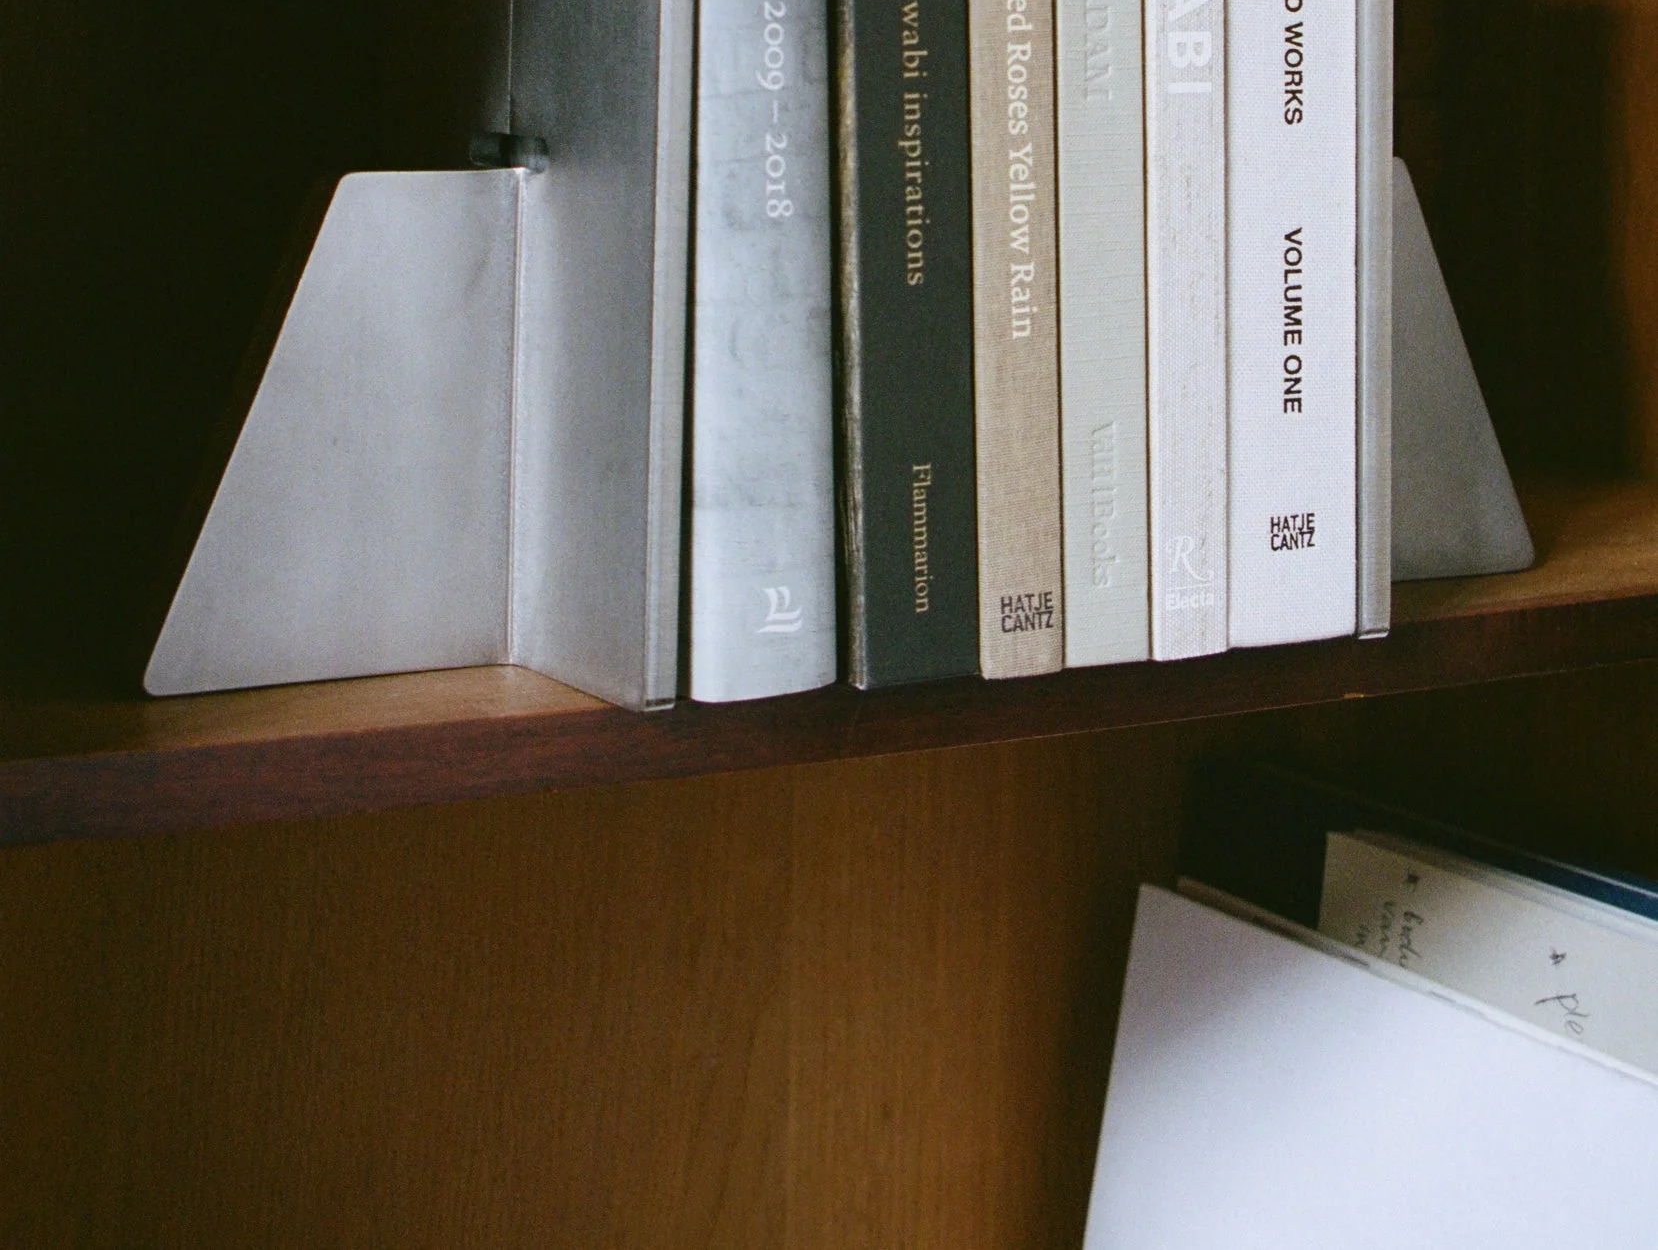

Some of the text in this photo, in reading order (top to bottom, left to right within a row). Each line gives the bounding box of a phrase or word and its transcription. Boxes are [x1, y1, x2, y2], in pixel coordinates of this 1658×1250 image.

[758, 1, 788, 91] 2009
[902, 0, 928, 78] wabi
[1283, 21, 1304, 126] WORKS
[1006, 40, 1033, 136] Roses
[764, 131, 793, 220] 2018
[898, 92, 928, 286] inspirations
[1008, 142, 1037, 255] Yellow
[1010, 261, 1039, 340] Rain
[1283, 227, 1303, 347] VOLUME
[1283, 354, 1303, 414] ONE
[912, 463, 934, 614] Flammarion
[1270, 512, 1315, 534] HATJE
[1270, 530, 1315, 551] CANTZ
[1001, 591, 1053, 614] HATJE
[1002, 610, 1053, 633] CANTZ
